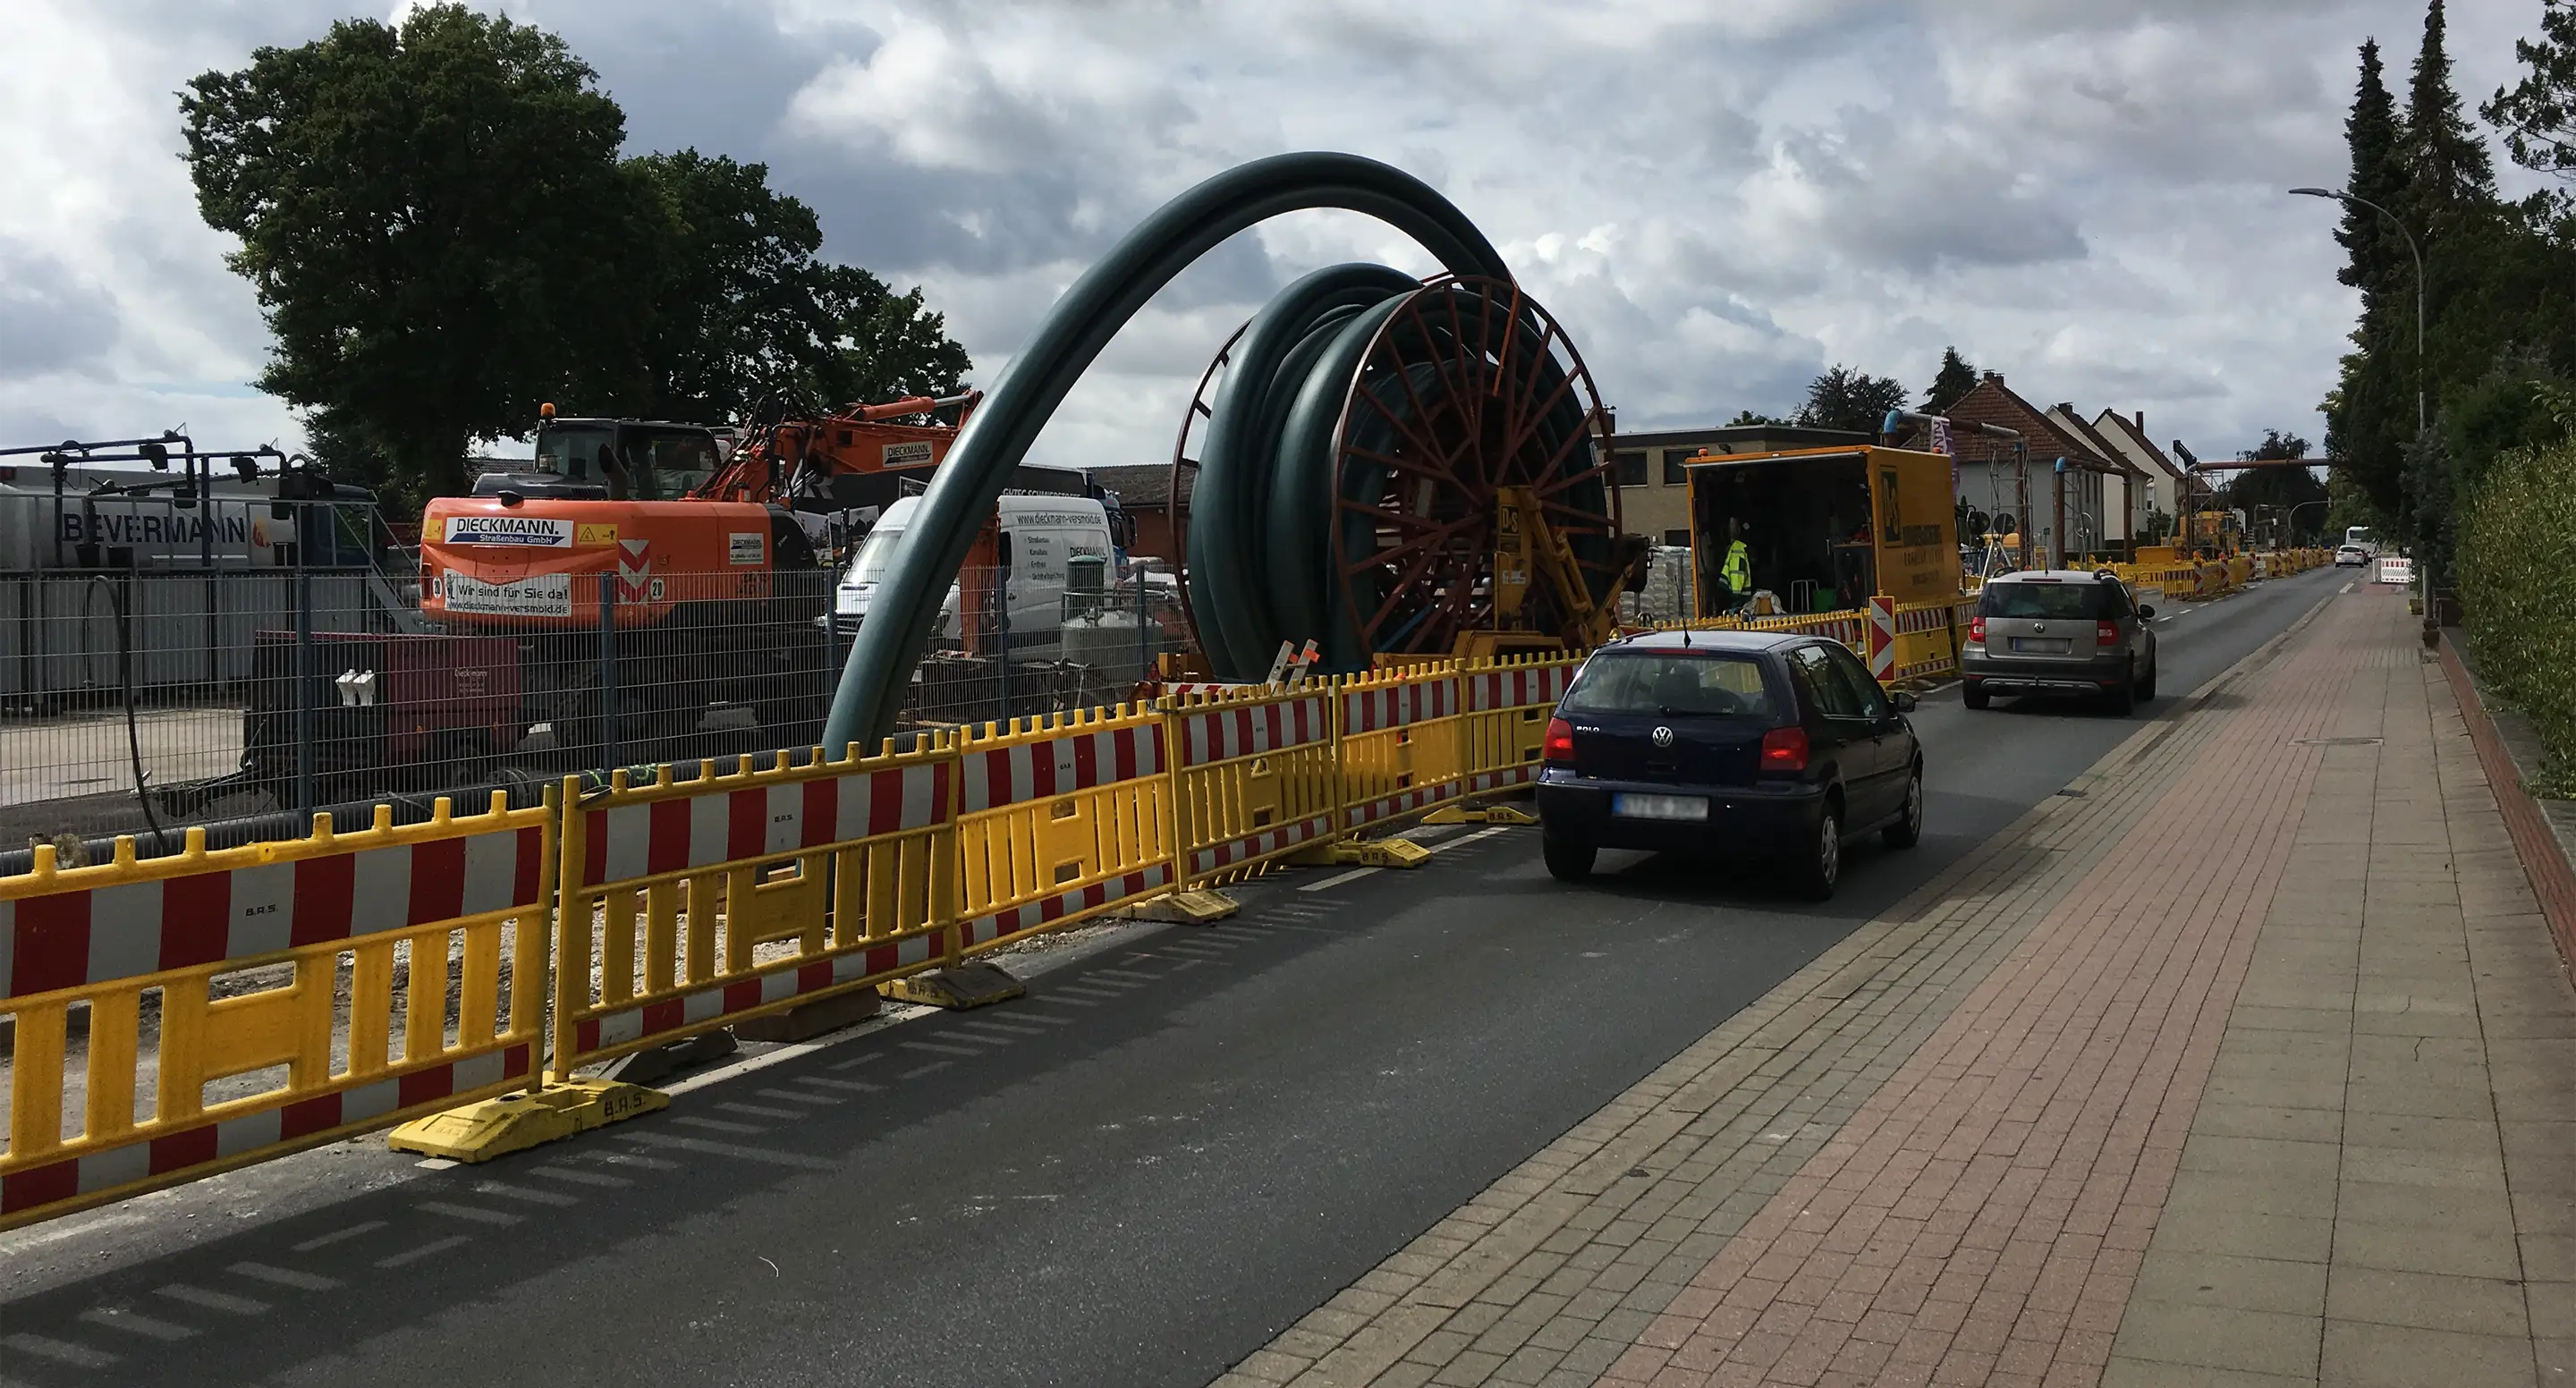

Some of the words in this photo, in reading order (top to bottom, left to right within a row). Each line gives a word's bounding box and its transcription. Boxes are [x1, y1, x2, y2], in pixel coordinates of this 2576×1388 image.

[64, 512, 247, 544] BEVERMANN
[456, 518, 560, 536] DIECKMANN.
[527, 536, 553, 545] GmbH
[458, 585, 476, 597] Wir
[478, 585, 500, 597] sind
[504, 586, 521, 598] für
[524, 587, 543, 599] Sie
[547, 586, 568, 600] da!
[652, 581, 663, 597] 20
[246, 904, 278, 917] B.A.S.
